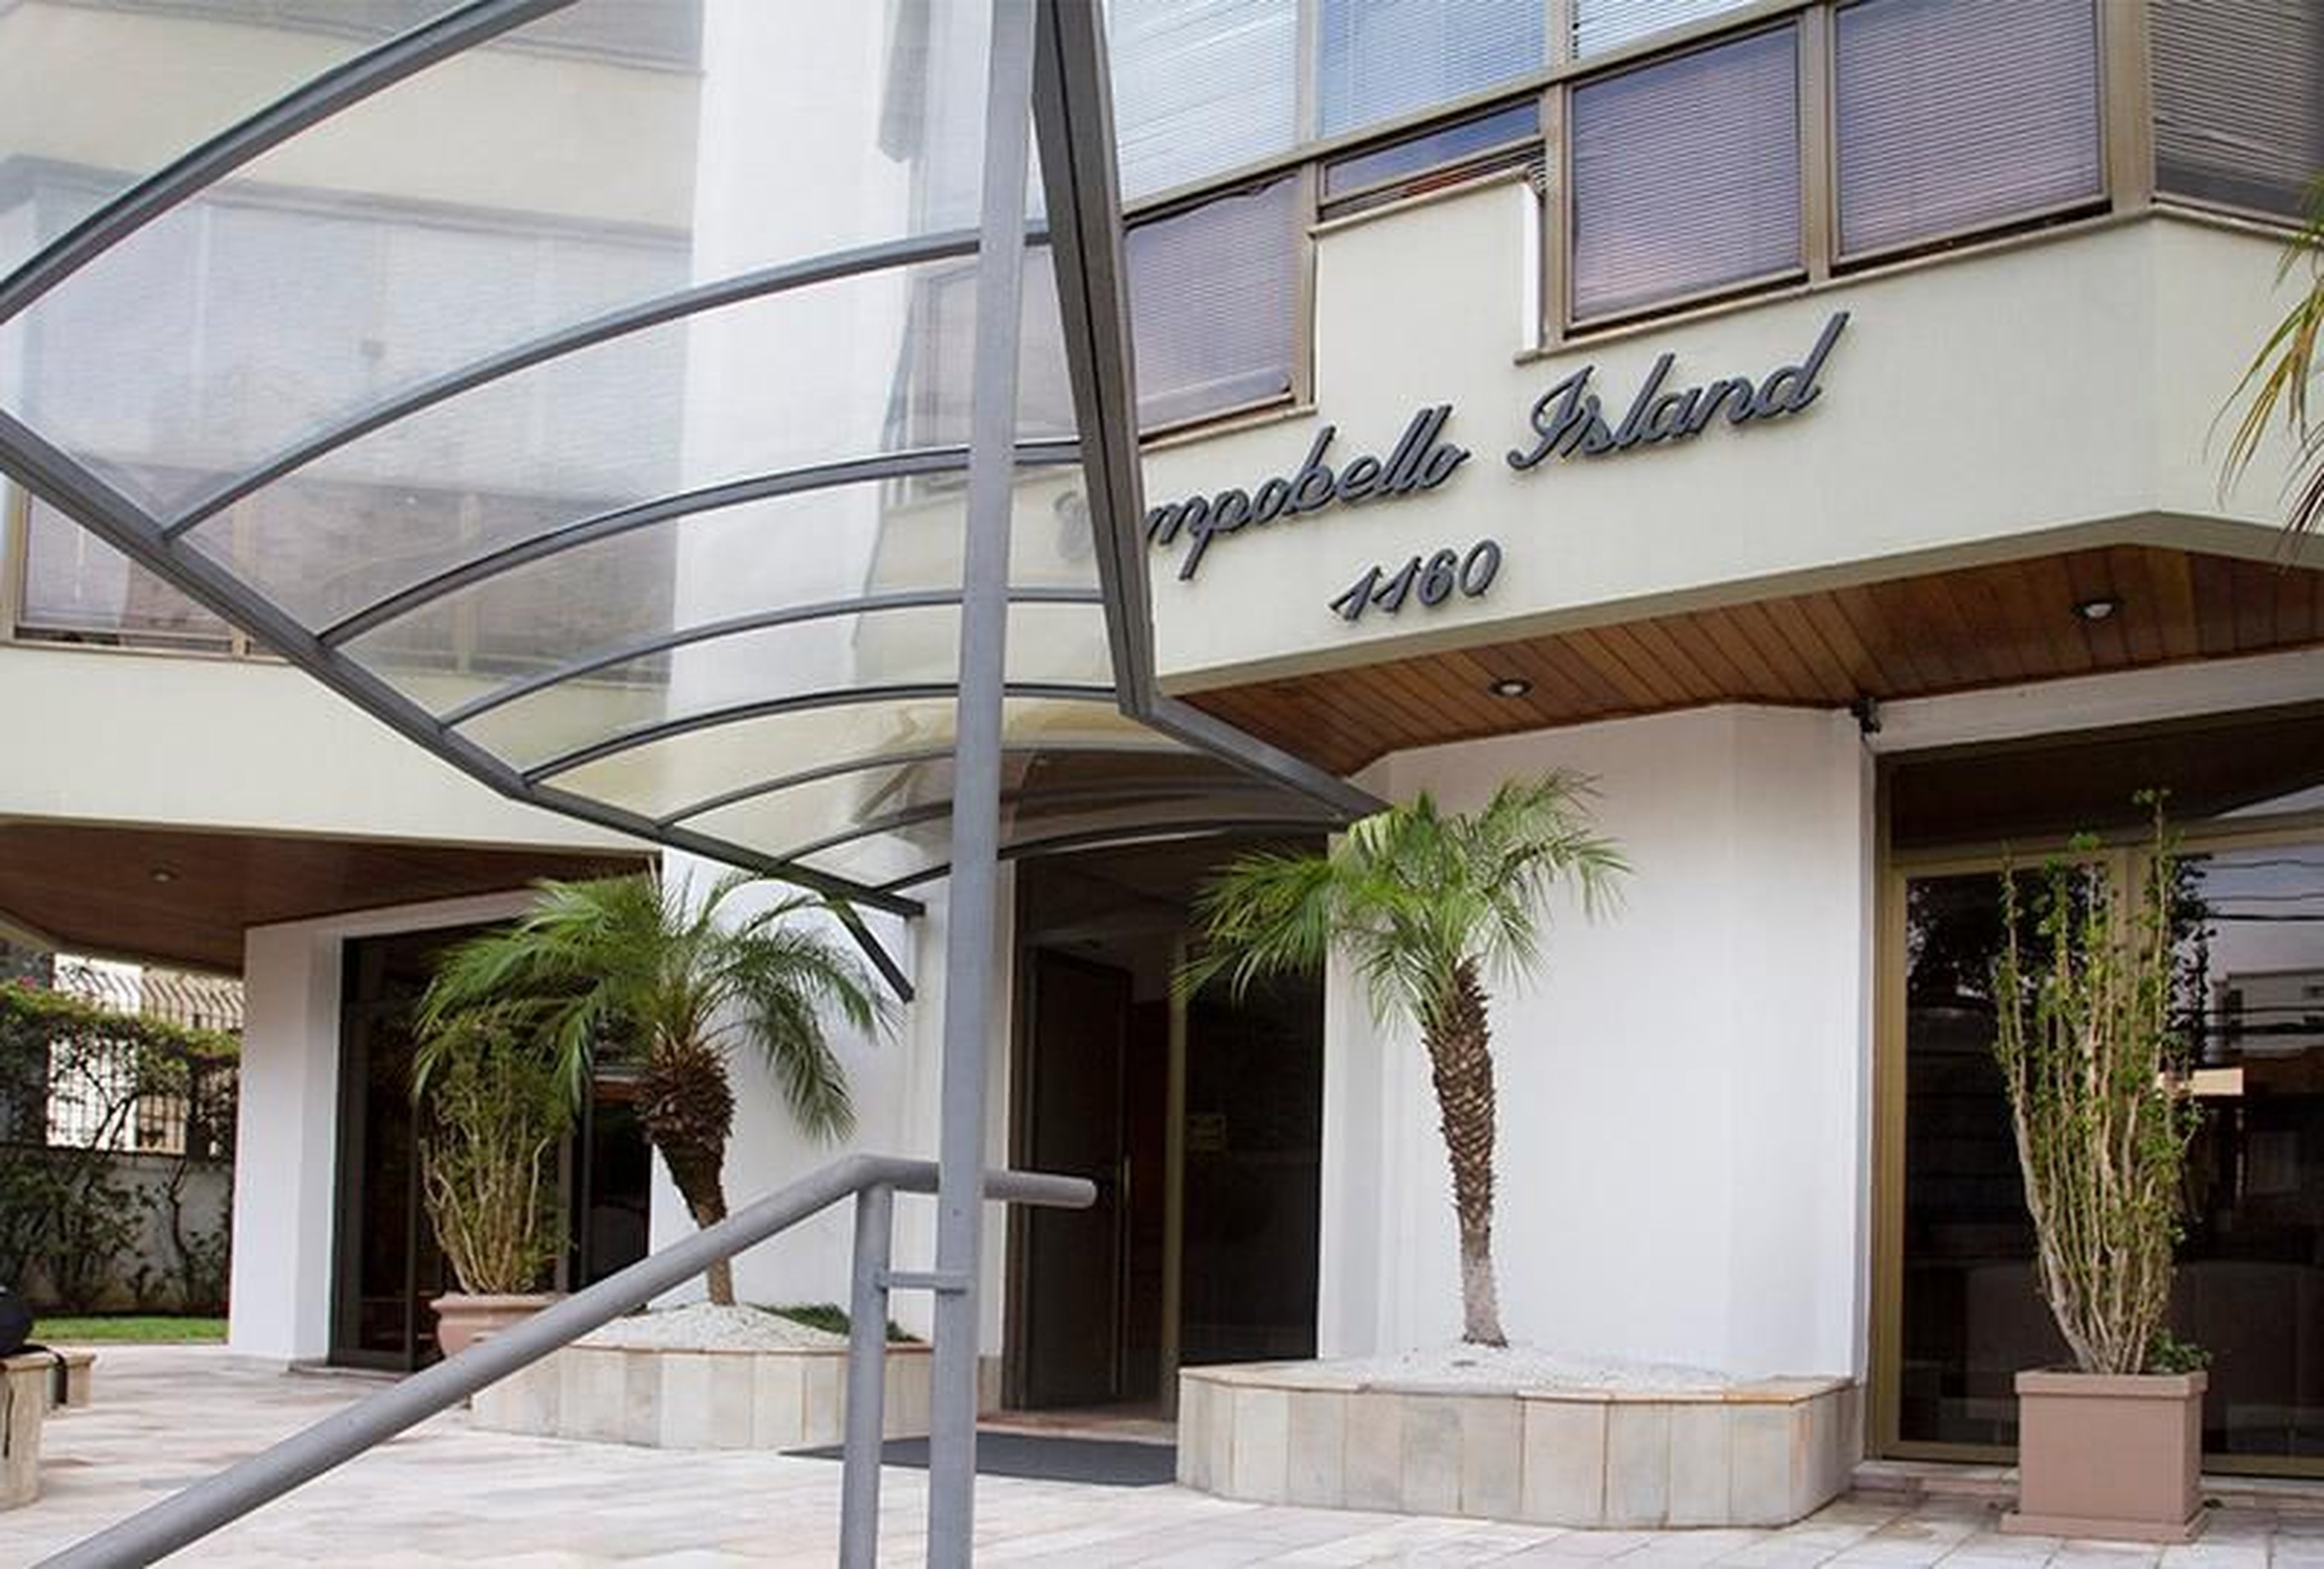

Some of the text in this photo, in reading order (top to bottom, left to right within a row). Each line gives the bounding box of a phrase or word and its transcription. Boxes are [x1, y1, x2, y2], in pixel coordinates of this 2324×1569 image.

[1054, 311, 1850, 581] mpobello Island
[1328, 540, 1502, 621] 1160
